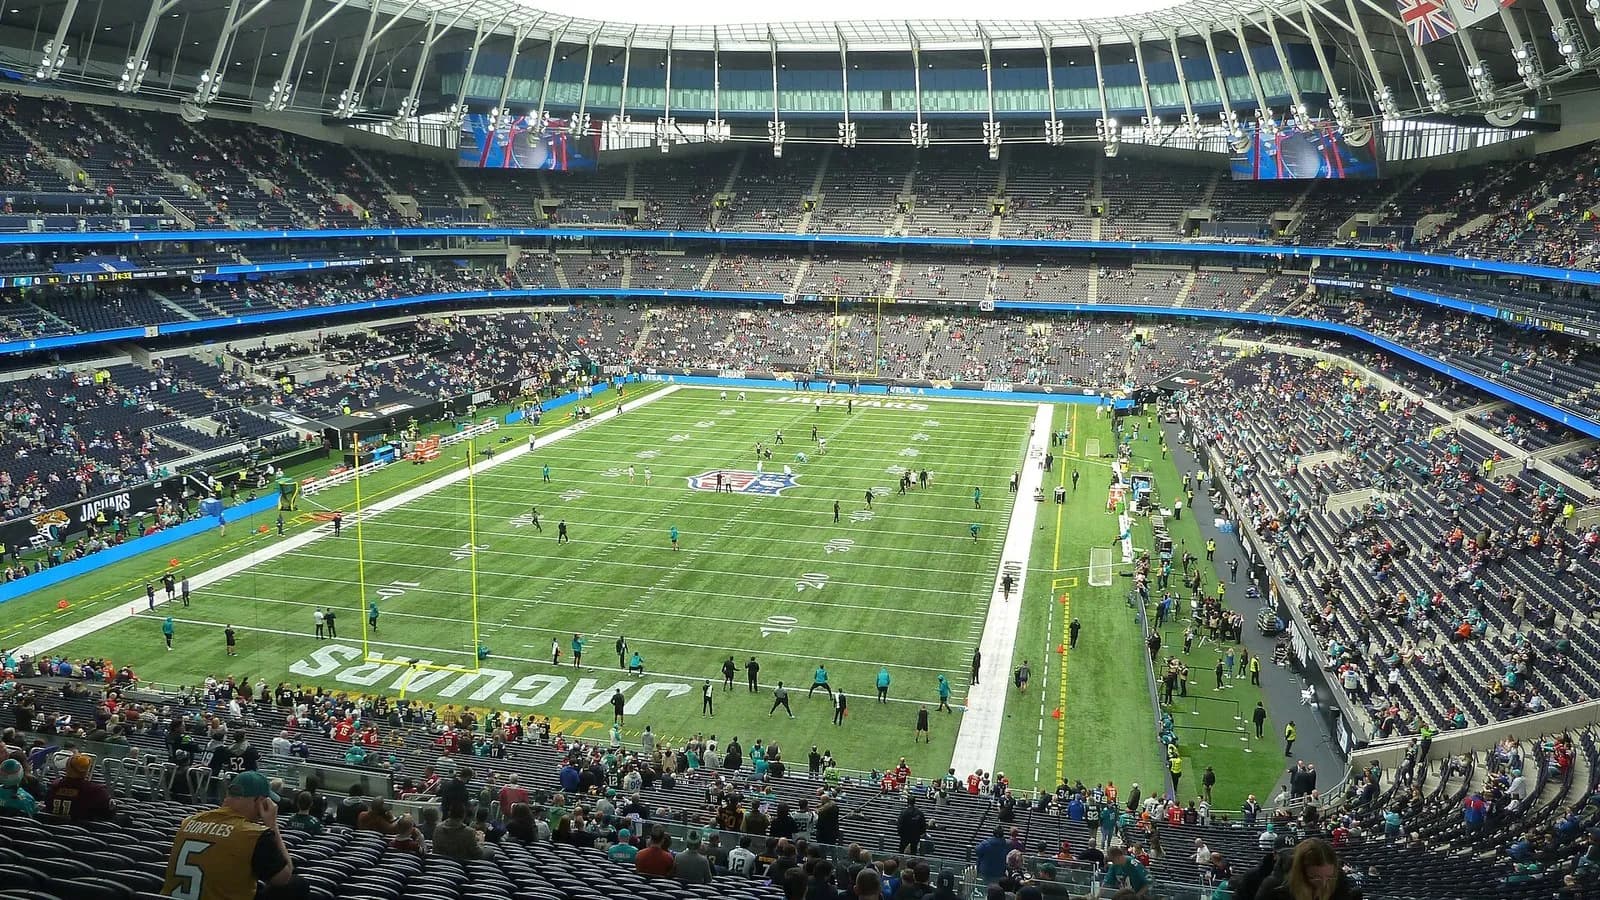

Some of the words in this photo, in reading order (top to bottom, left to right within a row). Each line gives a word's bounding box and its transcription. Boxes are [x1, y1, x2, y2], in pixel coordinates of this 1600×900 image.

[764, 396, 929, 411] JAGUARS
[823, 538, 855, 552] 30
[794, 572, 830, 590] 20
[760, 615, 799, 636] 10
[289, 644, 693, 715] JAGUARS
[230, 757, 246, 771] 52
[608, 775, 618, 787] 12
[1058, 789, 1070, 800] 34
[1087, 811, 1099, 821] 92
[183, 819, 234, 838] BORTLES
[171, 840, 212, 900] 5
[731, 857, 746, 874] 12
